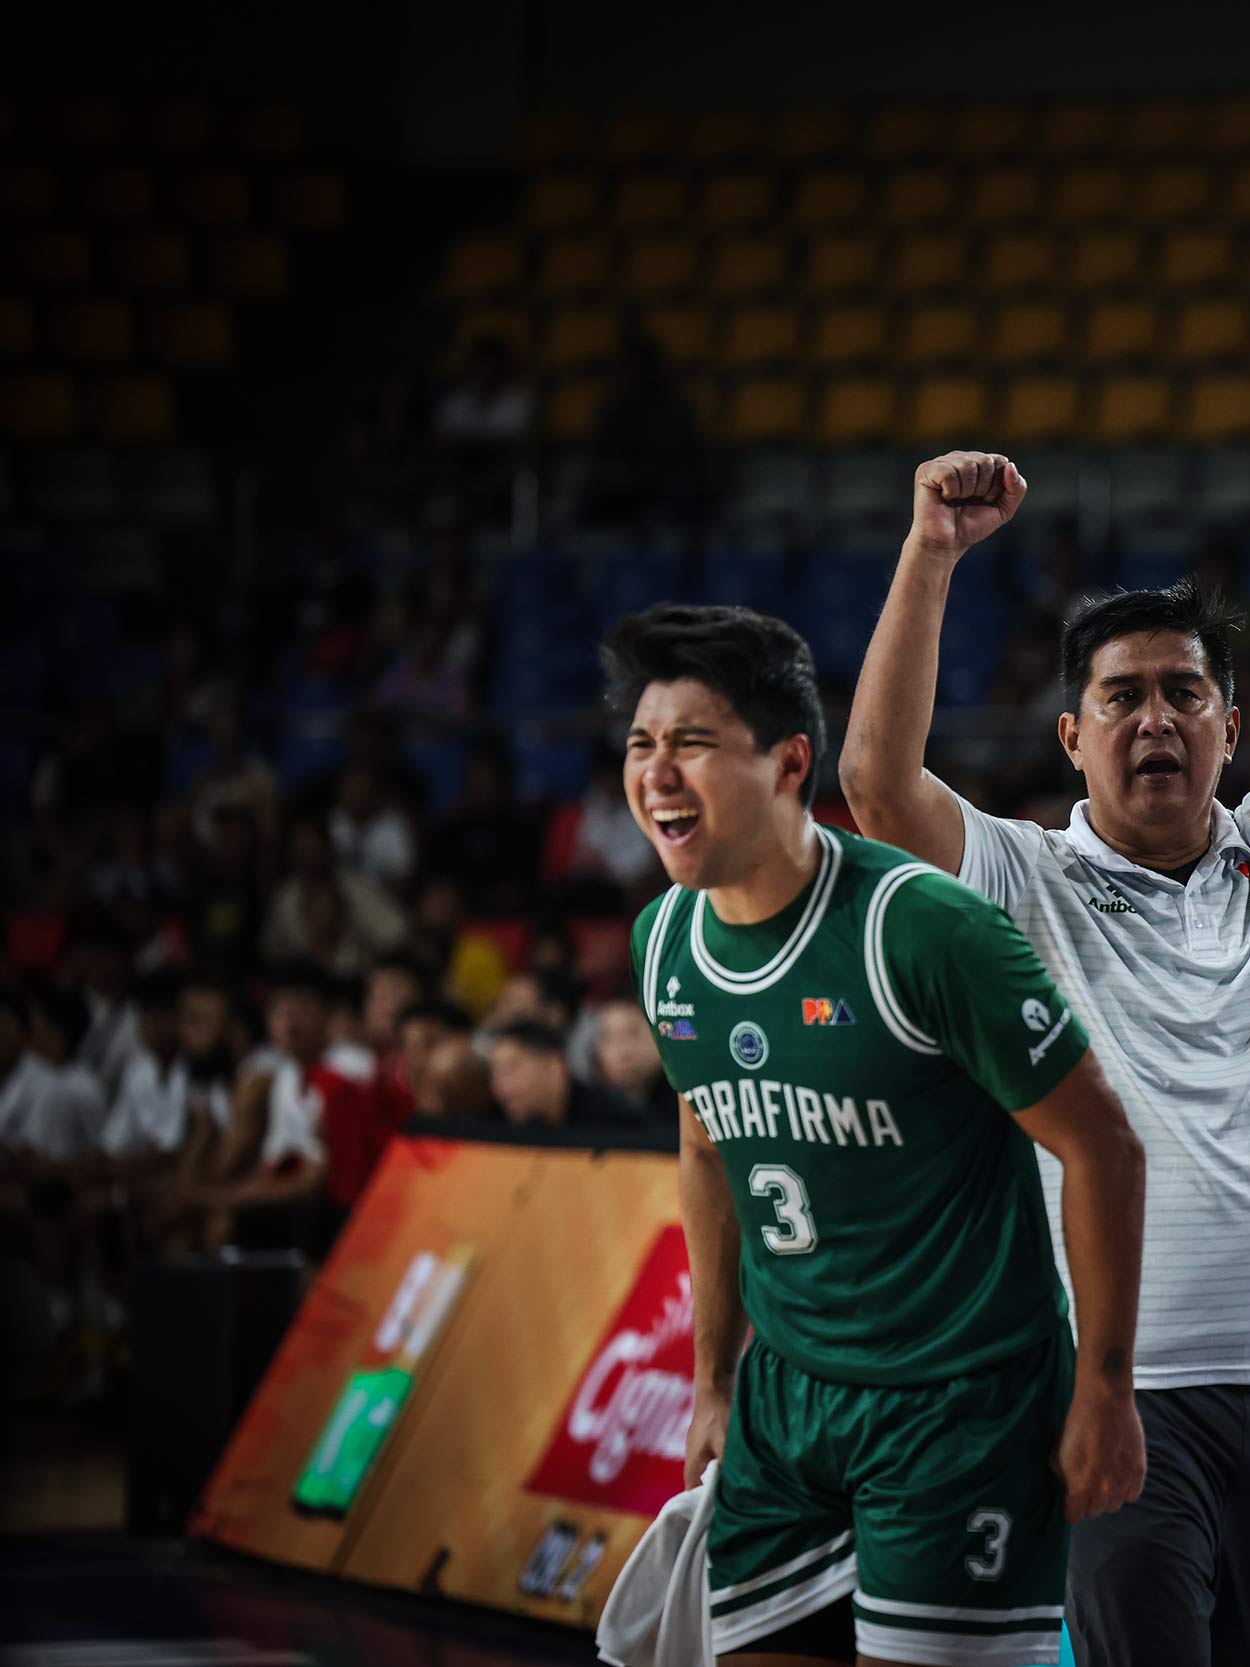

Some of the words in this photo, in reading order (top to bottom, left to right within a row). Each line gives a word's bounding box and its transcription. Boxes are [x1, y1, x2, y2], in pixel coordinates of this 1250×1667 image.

[1089, 897, 1137, 914] Antbo
[683, 1078, 904, 1147] RRAFIRMA
[749, 1163, 818, 1256] 3
[963, 1506, 1013, 1581] 3
